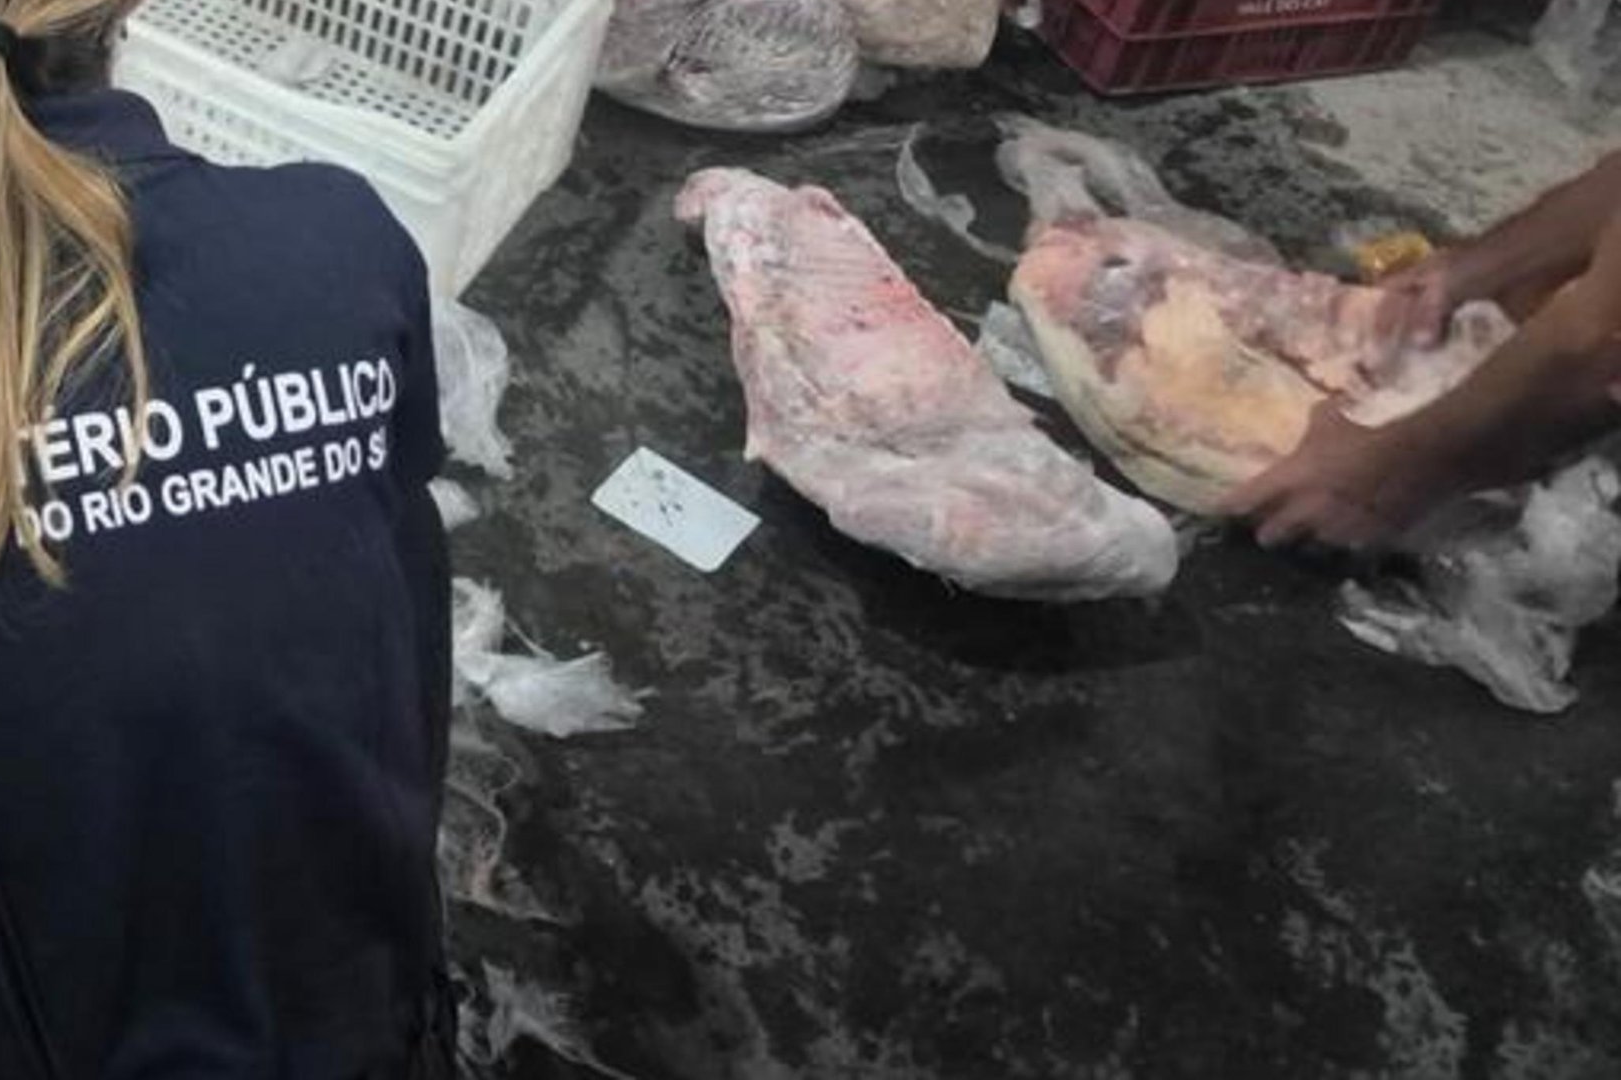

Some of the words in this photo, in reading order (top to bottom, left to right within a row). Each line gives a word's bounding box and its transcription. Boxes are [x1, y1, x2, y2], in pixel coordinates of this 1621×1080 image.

[80, 487, 153, 535] RIO
[161, 447, 320, 516] GRANDE
[323, 437, 363, 483] DO
